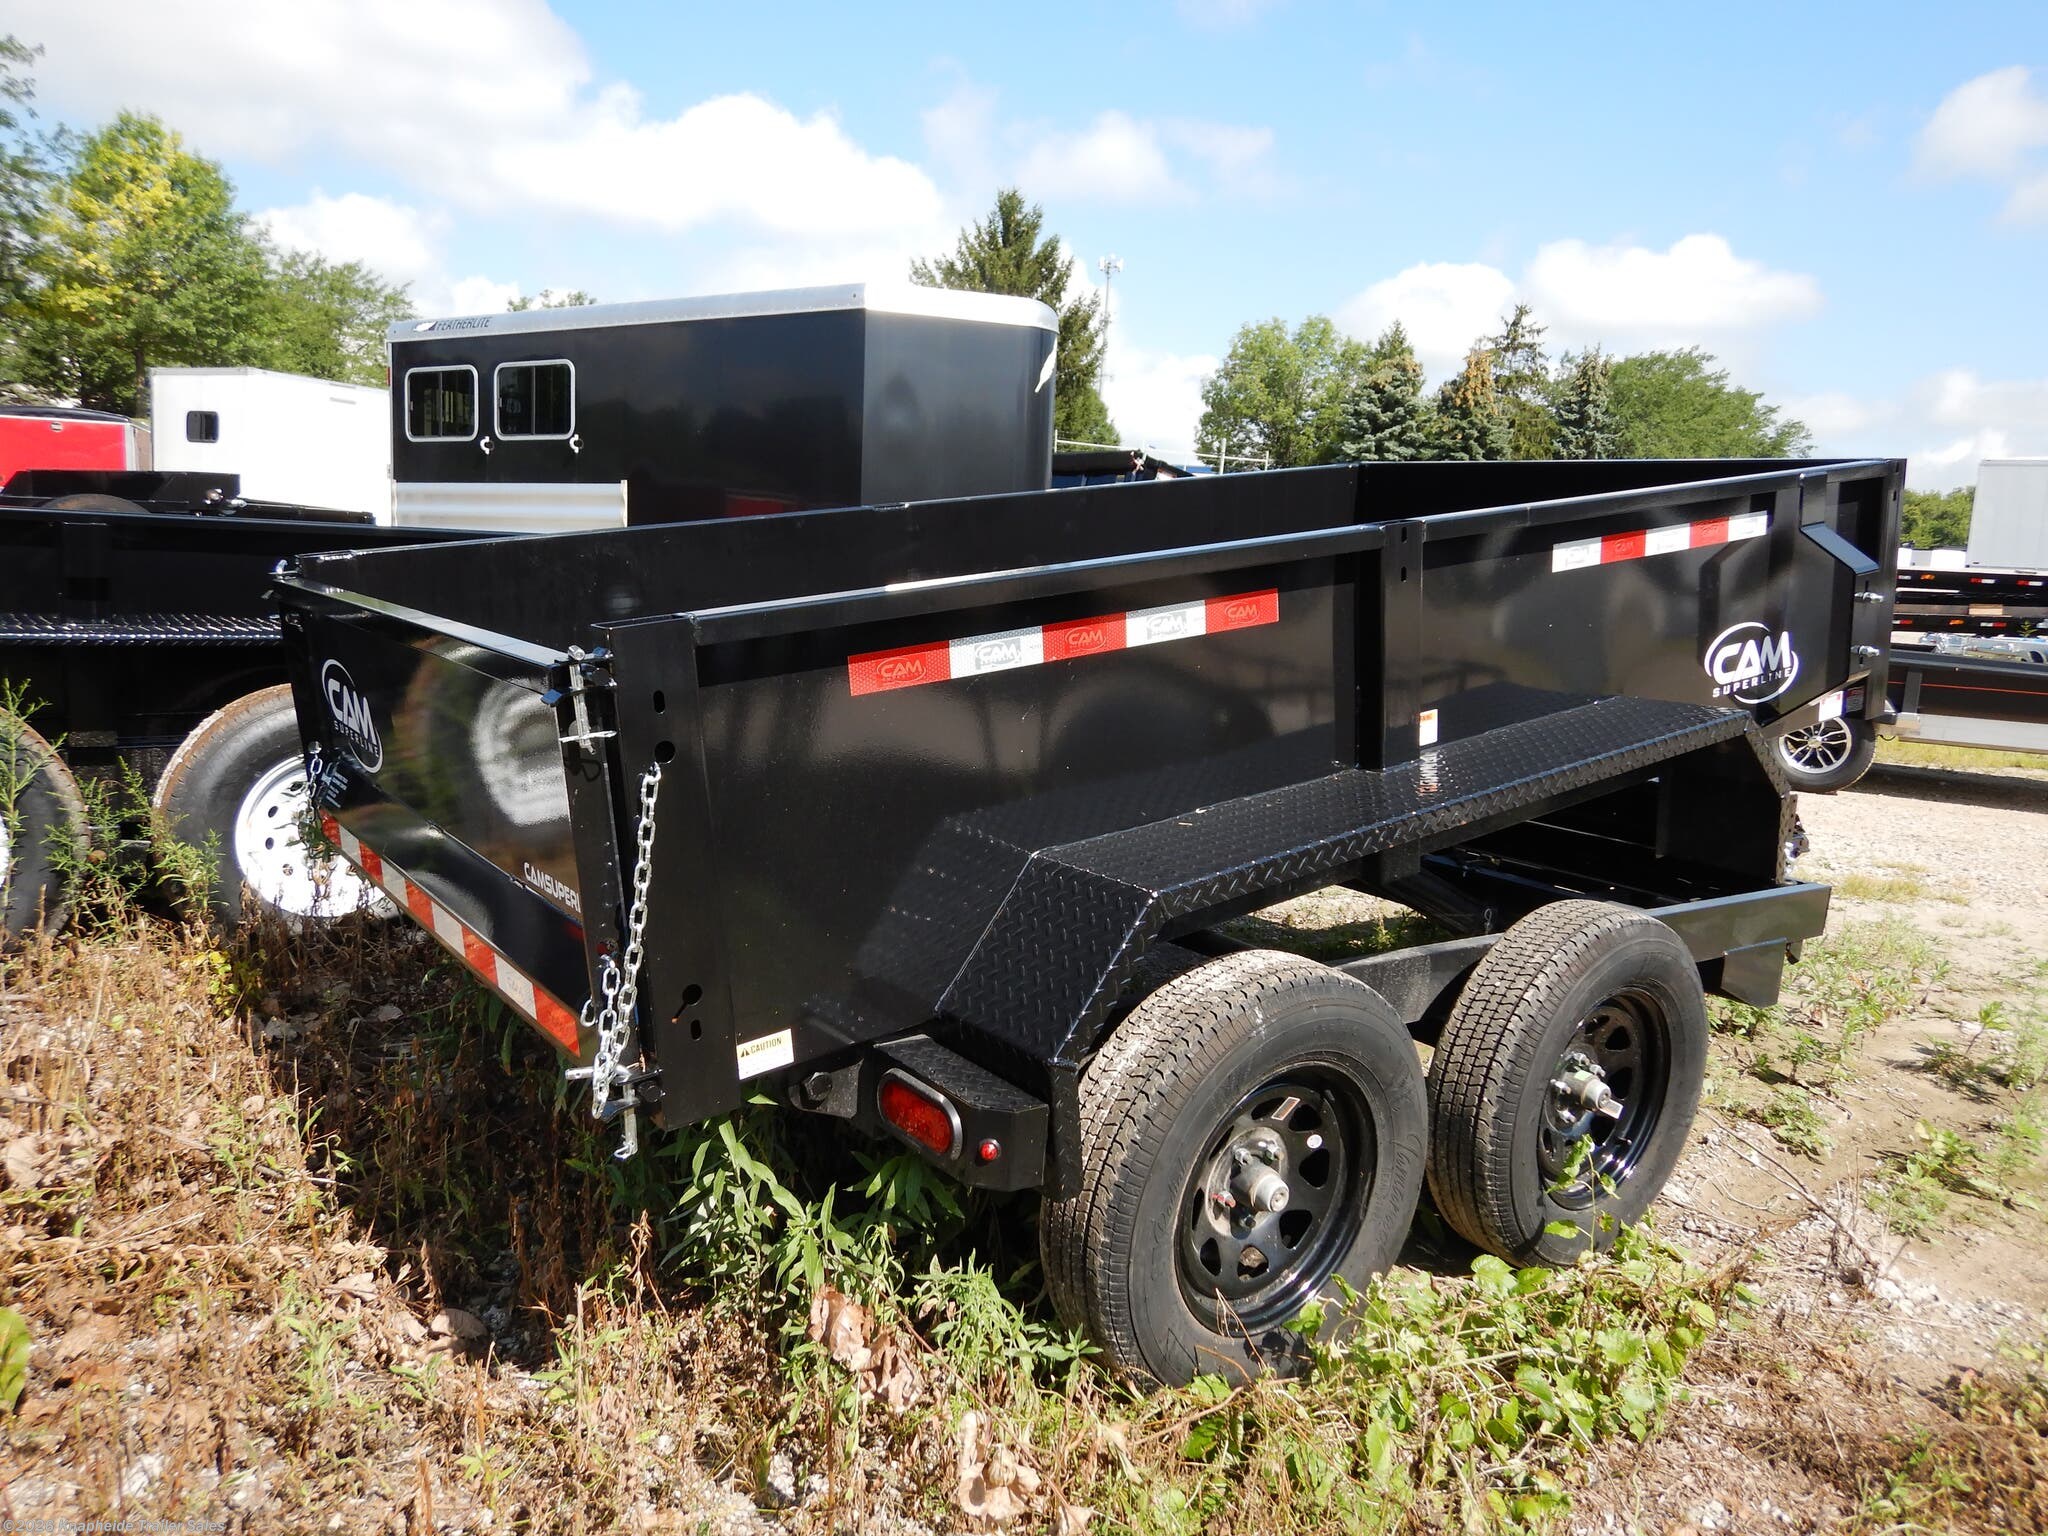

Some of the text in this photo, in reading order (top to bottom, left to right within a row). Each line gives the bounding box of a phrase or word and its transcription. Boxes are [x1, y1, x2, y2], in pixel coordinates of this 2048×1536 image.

[437, 317, 492, 331] FEATHERLITE
[1227, 603, 1258, 618] CAM
[1068, 628, 1104, 644] CAM
[977, 641, 1019, 660] CAM
[1713, 631, 1792, 685] CAM
[881, 658, 923, 678] CAM
[1712, 667, 1793, 698] SUPERLINE
[328, 678, 378, 746] CAM
[334, 720, 379, 758] SUPERLINE
[750, 1037, 782, 1053] CAUTION
